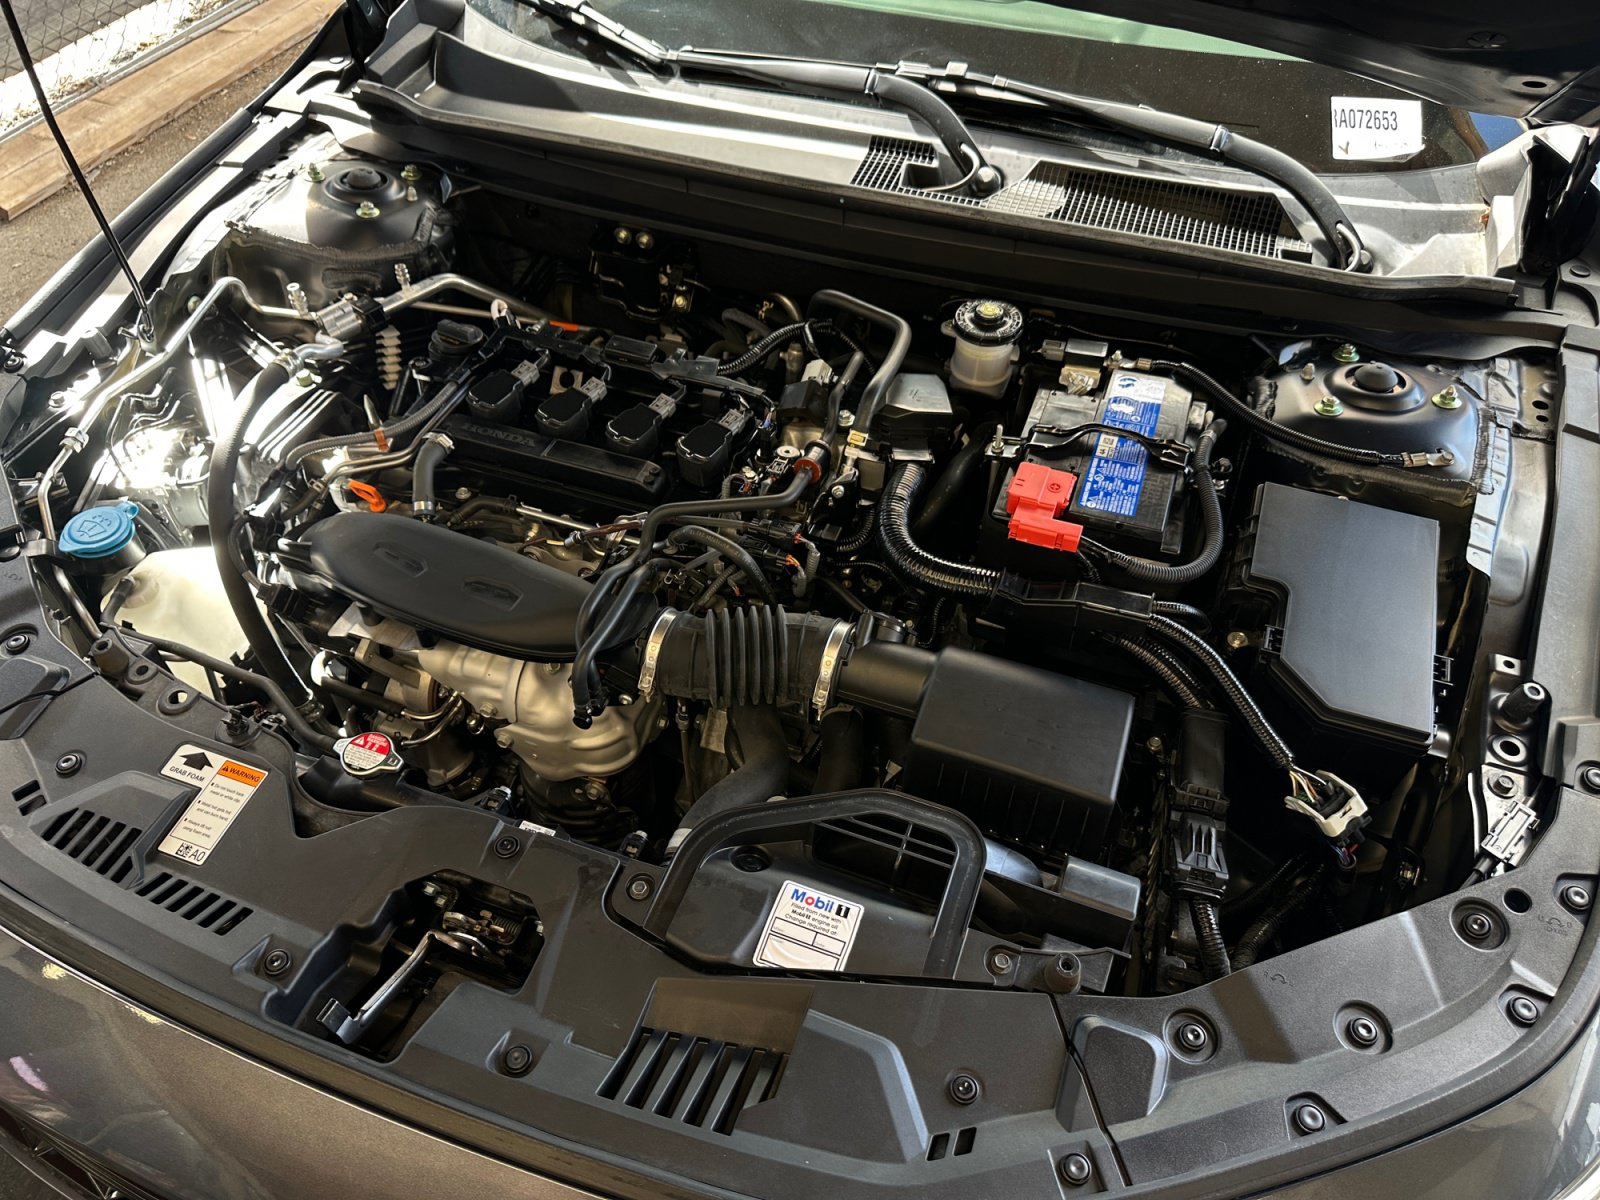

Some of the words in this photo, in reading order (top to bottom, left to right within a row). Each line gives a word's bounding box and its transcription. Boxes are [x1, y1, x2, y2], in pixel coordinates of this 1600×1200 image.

[461, 423, 535, 448] HONDA
[169, 766, 187, 777] GRAB
[187, 771, 206, 783] FOAM
[229, 767, 261, 783] WARNING
[790, 888, 835, 913] Mobil
[791, 909, 805, 918] Mobil
